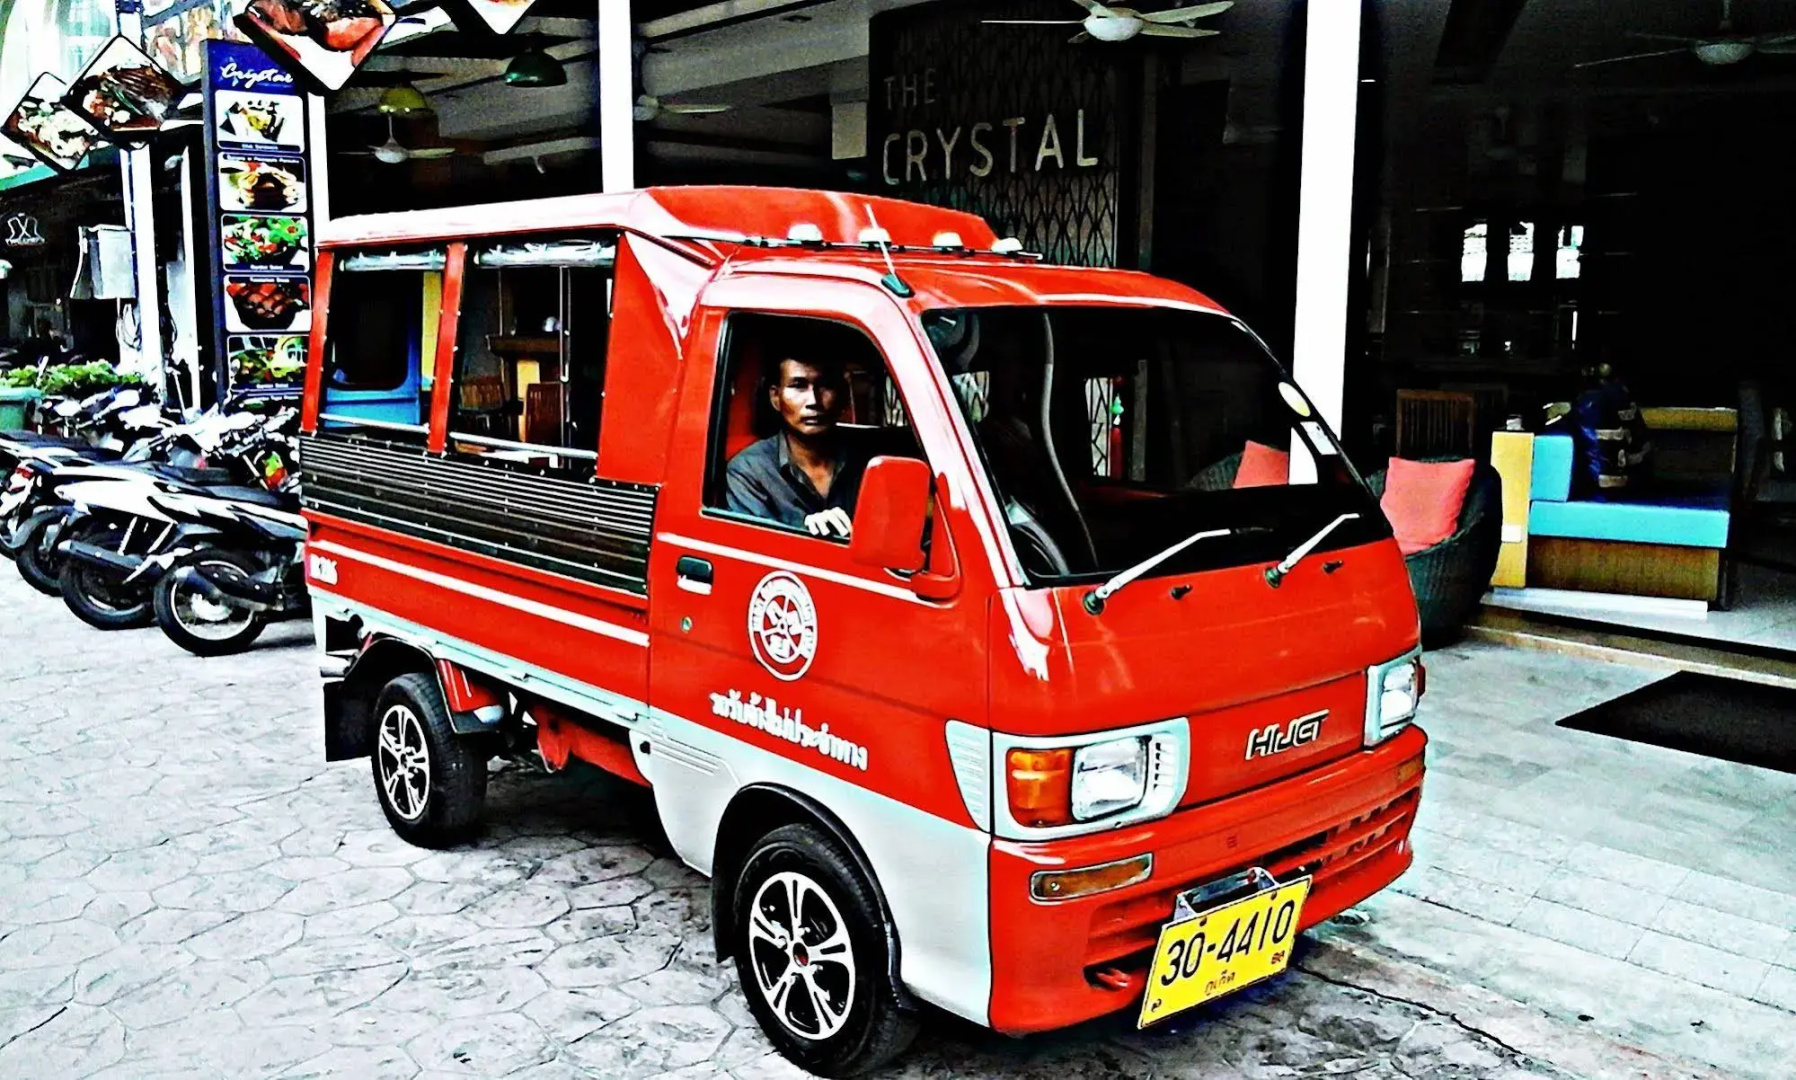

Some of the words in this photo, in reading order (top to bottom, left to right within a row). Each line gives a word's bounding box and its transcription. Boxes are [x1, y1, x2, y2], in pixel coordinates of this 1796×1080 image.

[884, 68, 937, 110] THE
[883, 108, 1099, 186] CRYSTAL
[1244, 708, 1330, 761] HIJET
[1161, 899, 1295, 987] 30-4410
